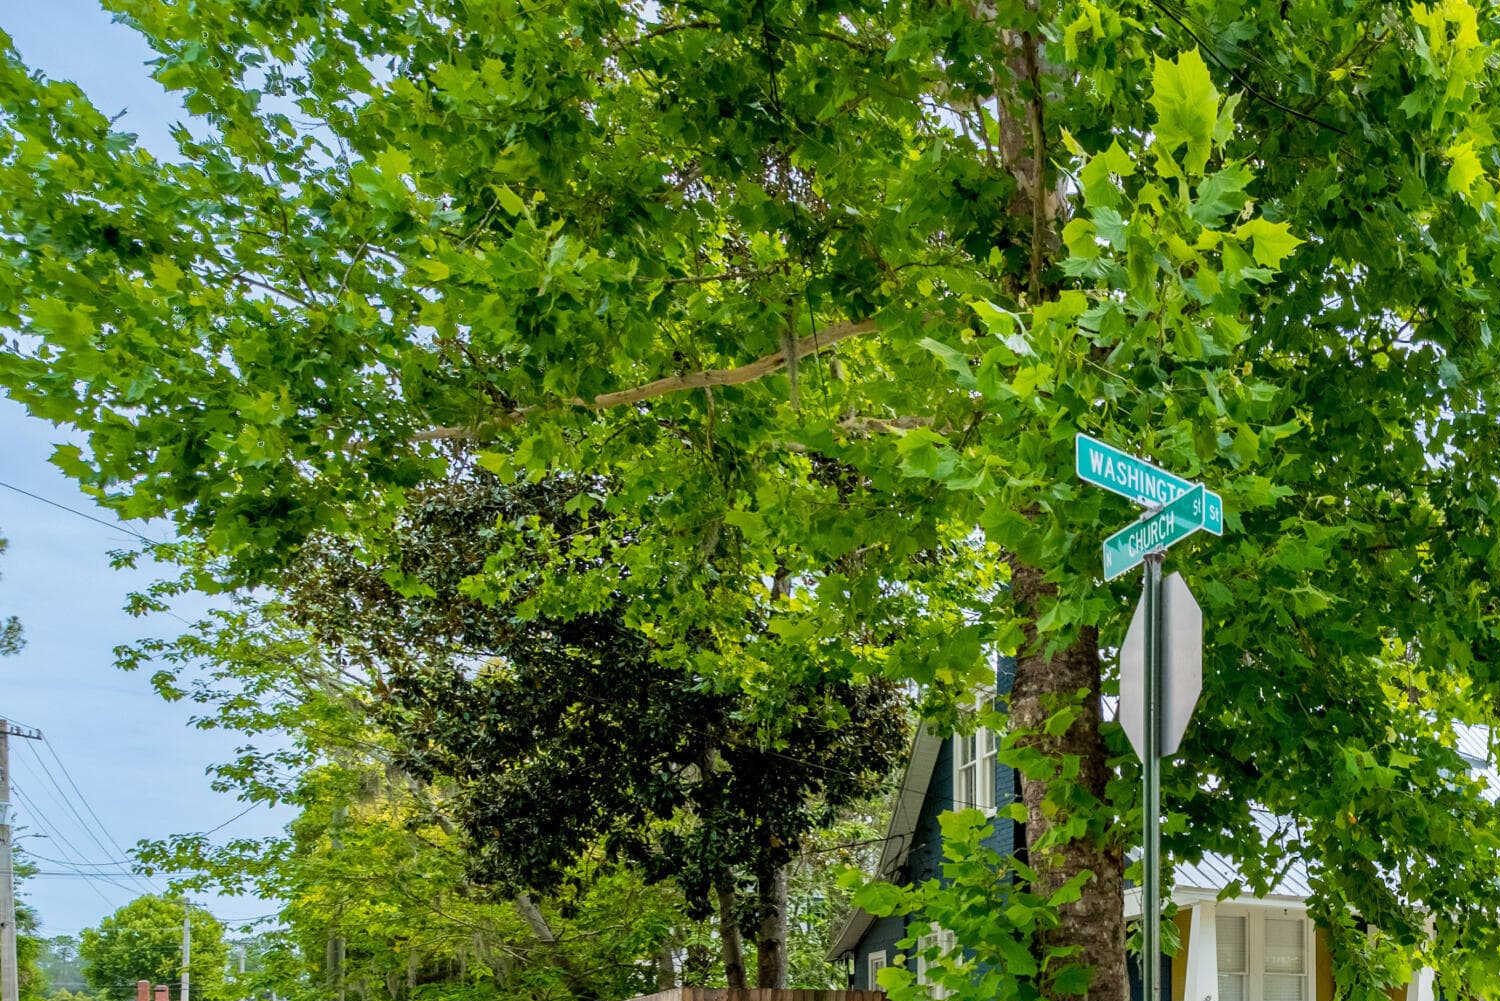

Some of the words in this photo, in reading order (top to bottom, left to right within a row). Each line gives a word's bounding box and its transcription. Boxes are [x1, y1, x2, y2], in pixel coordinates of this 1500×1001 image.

[1089, 447, 1186, 503] WASHINGT
[1209, 505, 1219, 522] St
[1105, 550, 1112, 569] N
[1128, 510, 1175, 558] CHURCH
[1192, 498, 1201, 516] St
